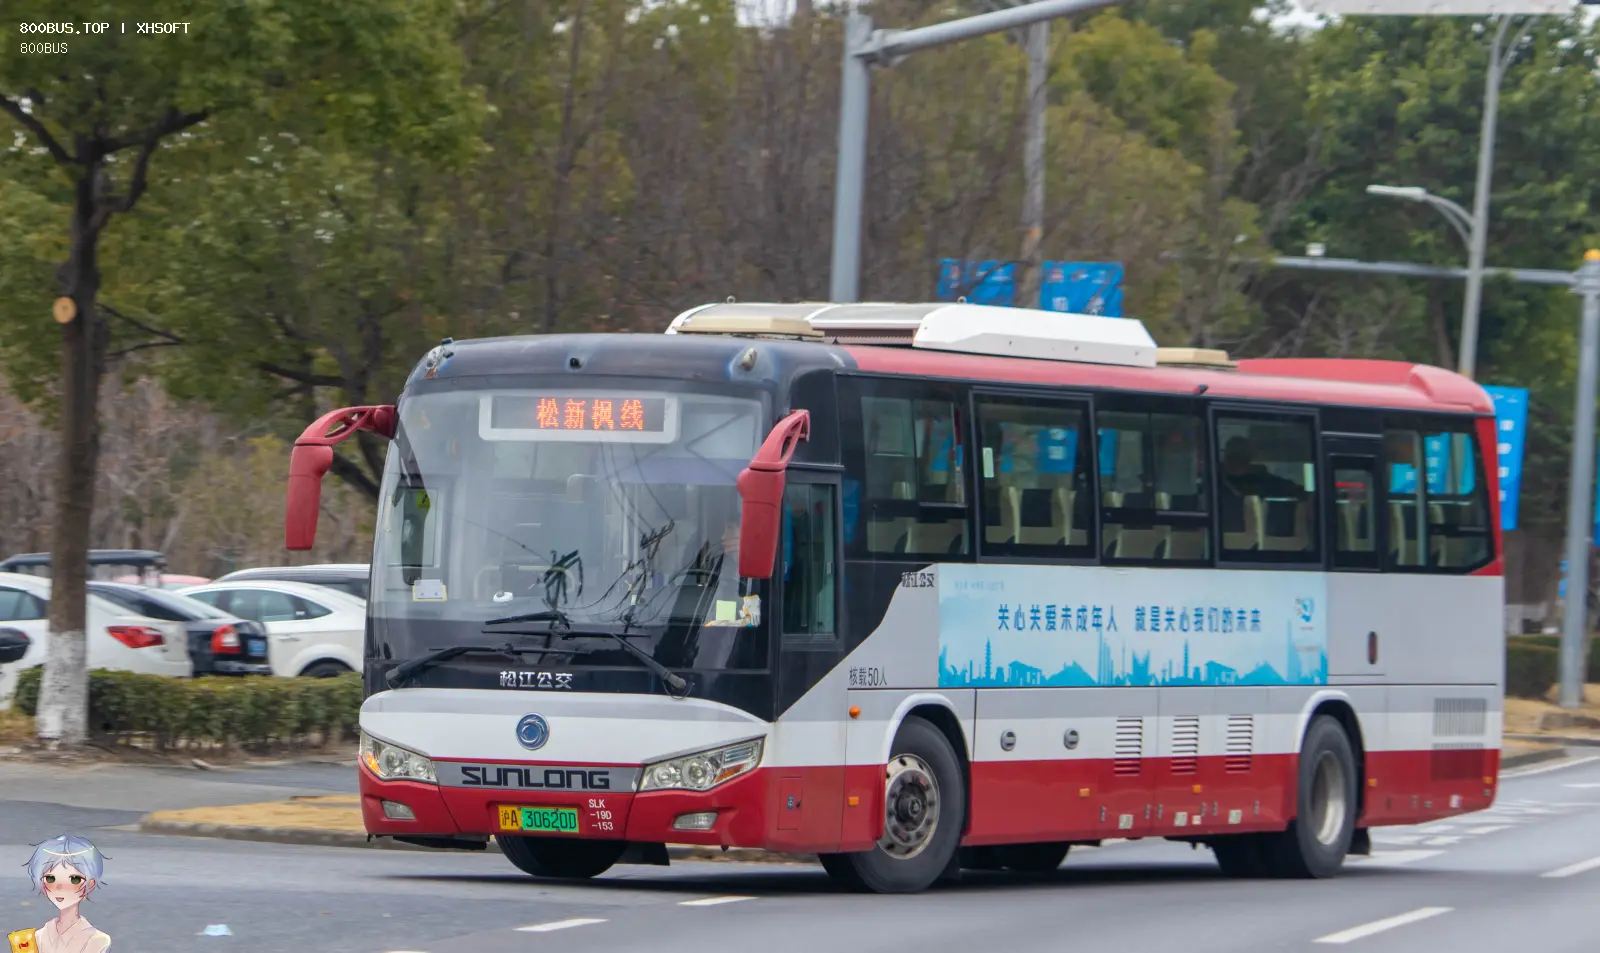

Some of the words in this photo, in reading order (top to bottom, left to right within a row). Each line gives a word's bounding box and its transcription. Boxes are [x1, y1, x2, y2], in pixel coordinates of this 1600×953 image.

[536, 397, 644, 431] 松新枫线
[900, 571, 935, 588] 松江公交
[997, 603, 1118, 632] 关心关爱未成年人
[1134, 605, 1262, 633] 就是关心我们的未来
[499, 671, 573, 690] 松江公交
[848, 665, 888, 687] 核载50人
[461, 766, 610, 790] SUNLONG
[588, 798, 606, 809] SLK
[525, 810, 577, 830] 30620D
[589, 810, 612, 820] -19D
[591, 821, 614, 831] -153
